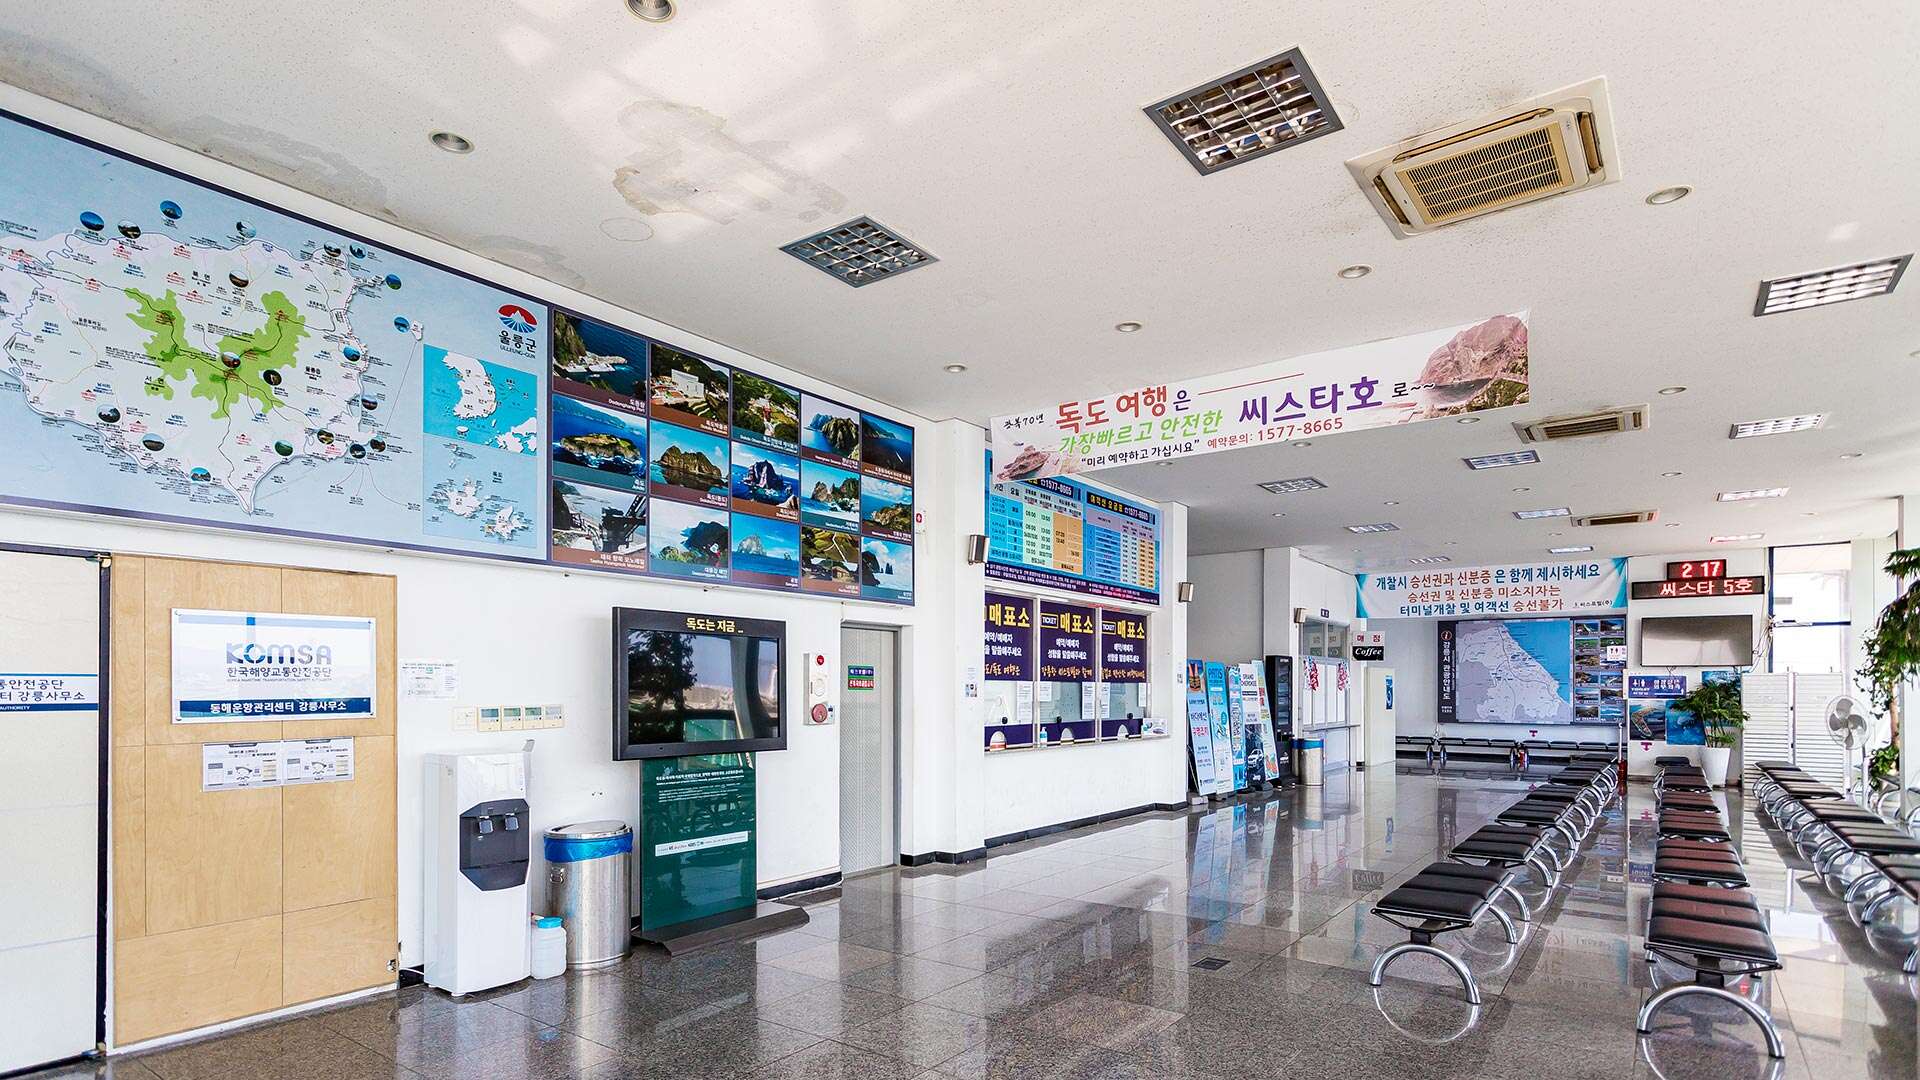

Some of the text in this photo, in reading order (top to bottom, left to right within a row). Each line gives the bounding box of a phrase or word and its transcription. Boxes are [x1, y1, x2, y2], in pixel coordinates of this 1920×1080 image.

[499, 330, 536, 353] 울릉군
[1056, 400, 1109, 434] 독도
[1116, 385, 1168, 418] 여행
[1173, 389, 1192, 412] 은
[1239, 376, 1383, 425] 씨스타호
[1059, 409, 1223, 456] 가장빠르고 안전한
[1207, 417, 1343, 449] 예약문의: 1577-8665
[1107, 448, 1149, 464] 예약하고
[1376, 563, 1601, 590] 개찰시 승선권과 신분증 은 함께 제시하세요
[1701, 561, 1720, 577] 17
[1408, 585, 1561, 603] 승선권 및 신분증 미소지자는
[1660, 578, 1753, 596] 씨스타 5호
[989, 603, 1030, 628] 매표소
[1400, 599, 1564, 616] 터미널개찰 및 여객선 승선불가
[687, 617, 736, 633] 독도는 지금
[1060, 612, 1094, 634] 매표소
[1117, 620, 1145, 639] 매표소
[226, 643, 332, 664] KOMSA
[1355, 647, 1382, 657] Coffee
[227, 667, 332, 677] 한국해양교통안전공단
[18, 691, 85, 702] 강릉사무소
[210, 701, 346, 714] 동해운항관리센터 강릉사무소
